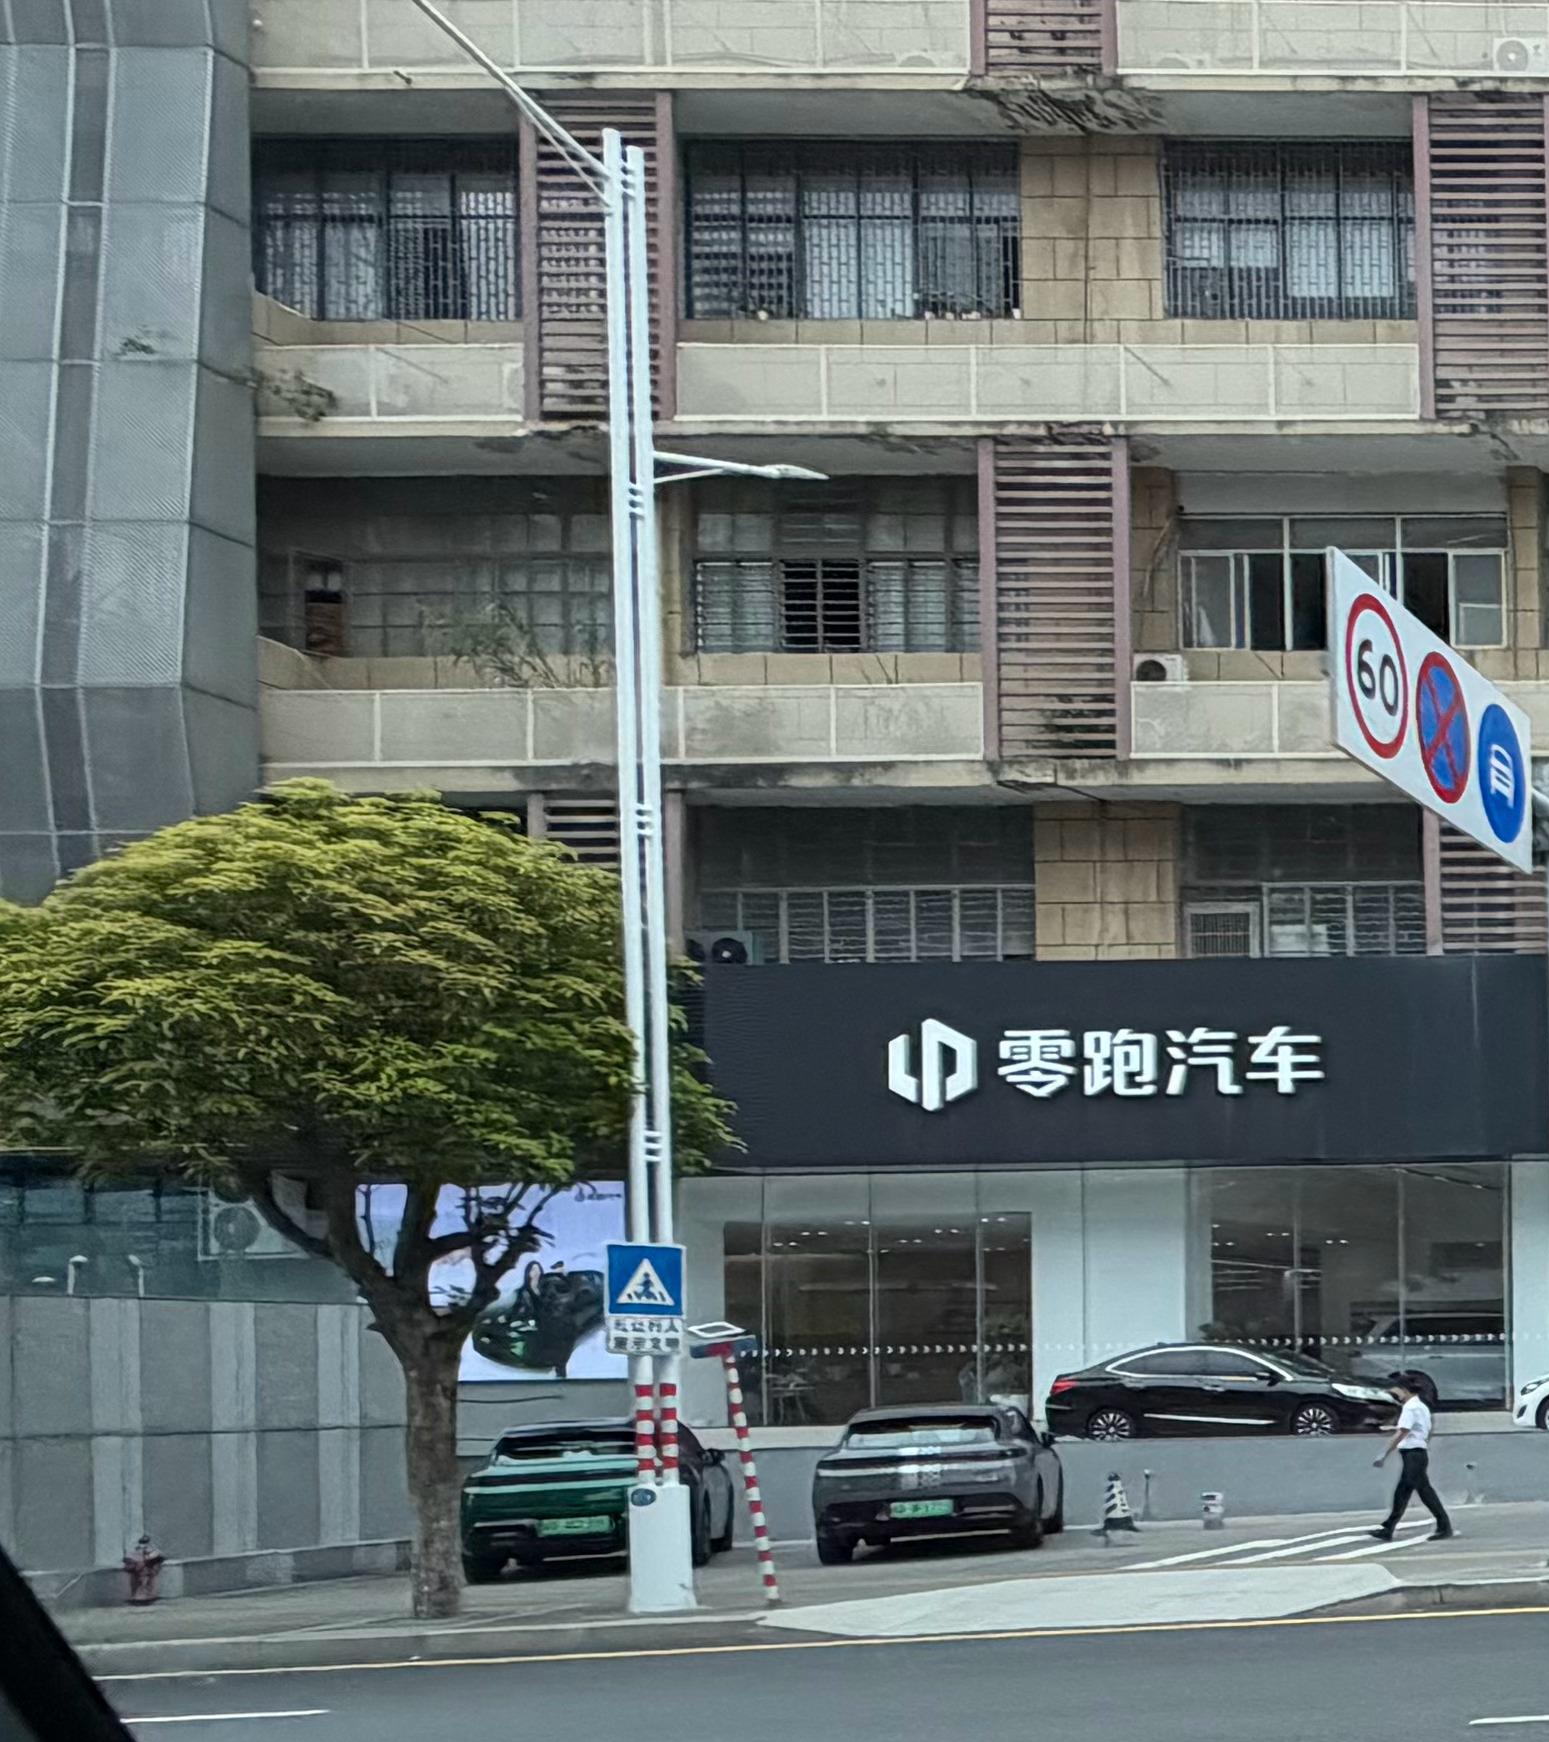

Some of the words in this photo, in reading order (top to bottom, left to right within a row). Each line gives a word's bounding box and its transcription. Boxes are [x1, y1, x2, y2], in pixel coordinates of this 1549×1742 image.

[1357, 639, 1398, 716] 60
[998, 1026, 1326, 1098] 零跑汽车
